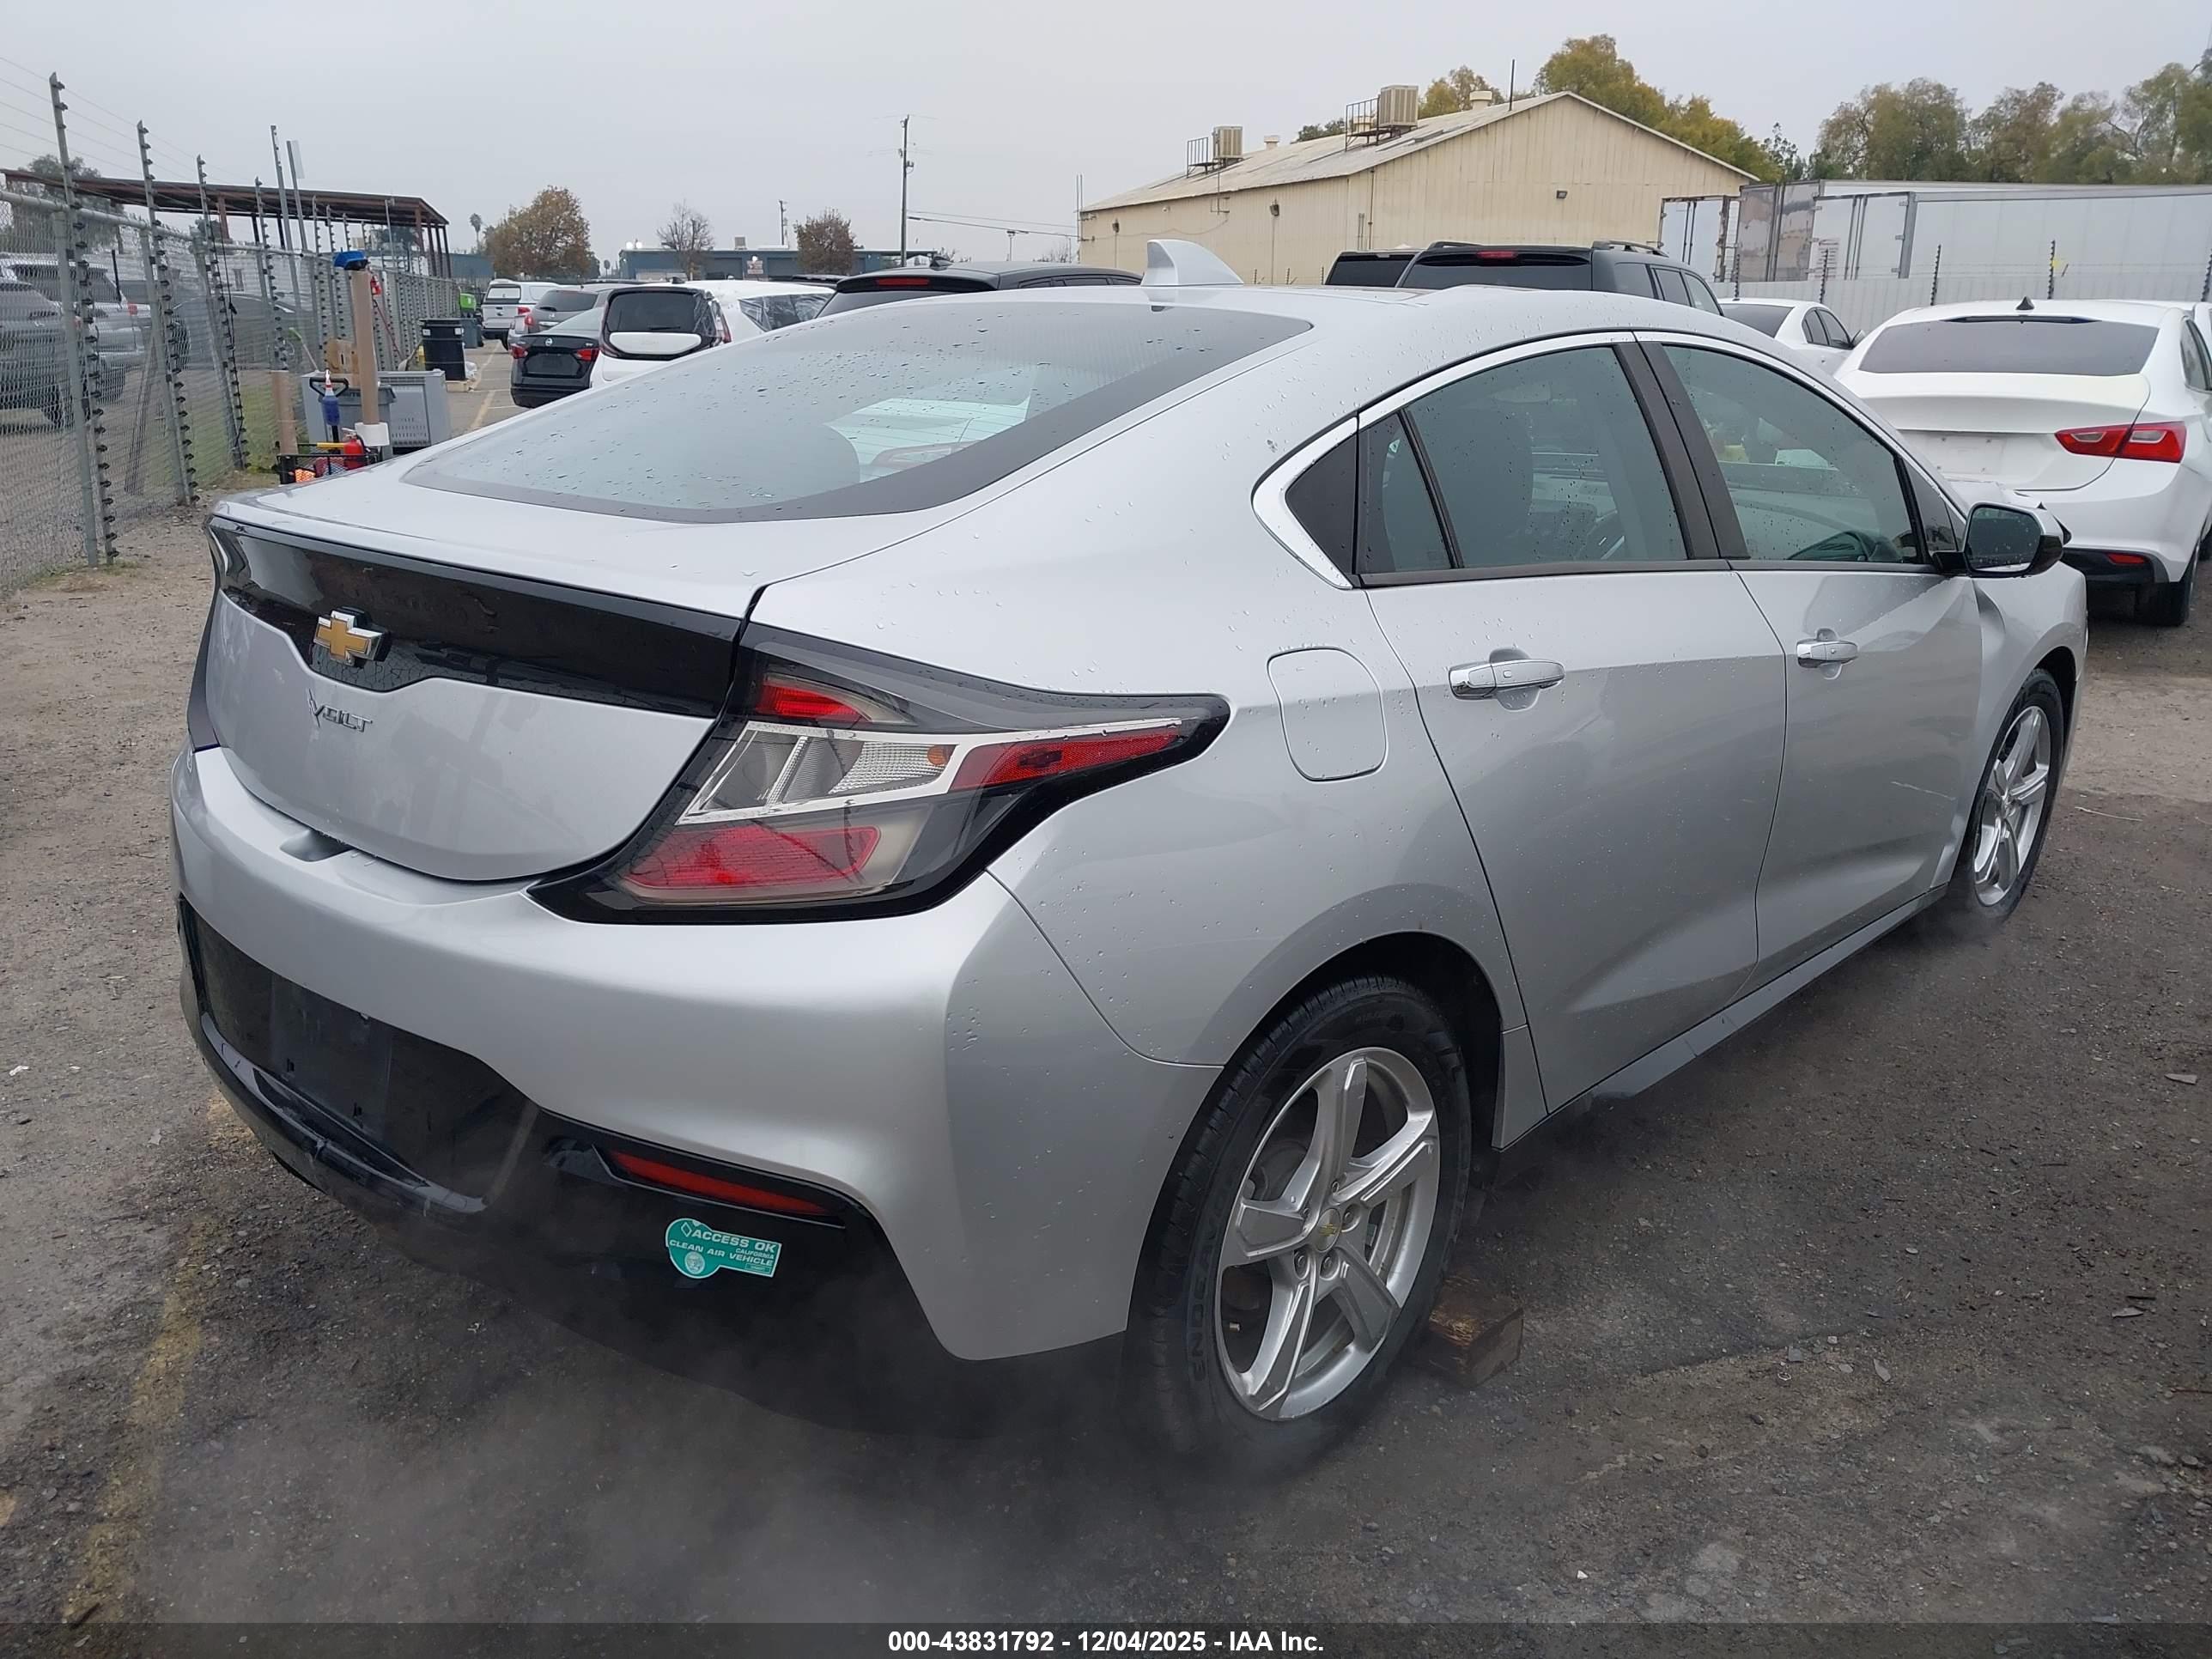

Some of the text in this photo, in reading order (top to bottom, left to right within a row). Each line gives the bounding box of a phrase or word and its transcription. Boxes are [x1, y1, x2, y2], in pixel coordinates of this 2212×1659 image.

[308, 688, 373, 732] VOLT
[669, 1239, 774, 1267] CLEAN AIR VEHICLE
[691, 1229, 776, 1253] ACCESS OK
[735, 1248, 775, 1260] CALIFORNIA
